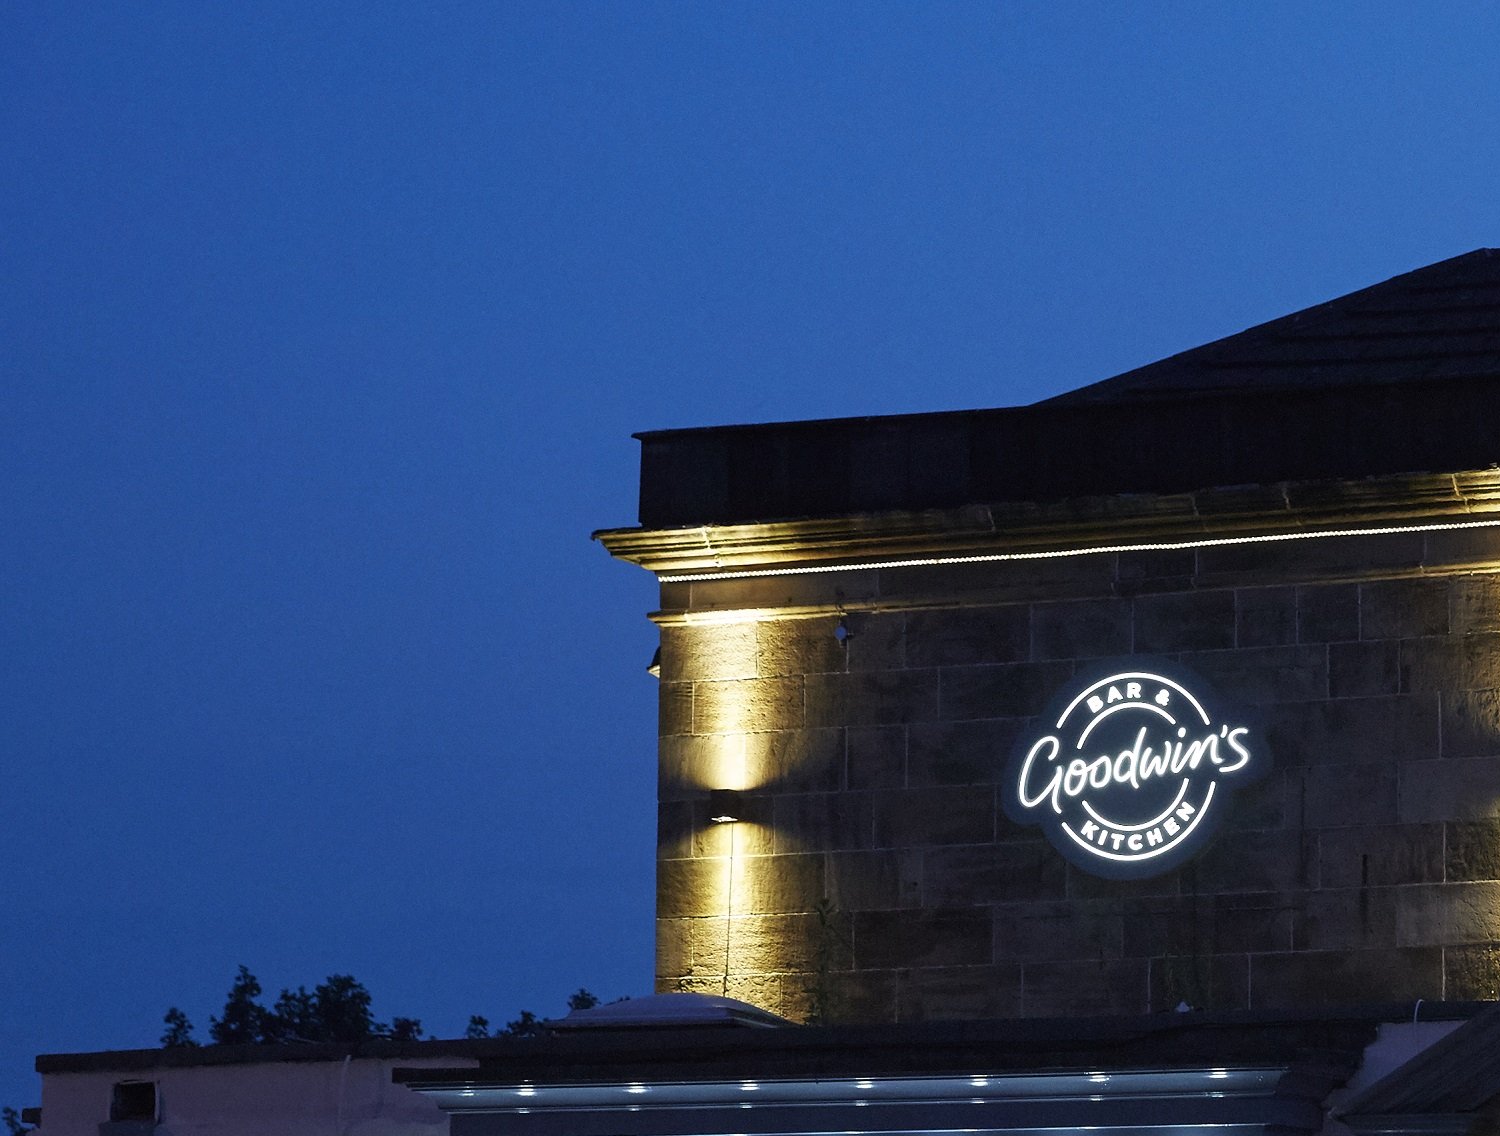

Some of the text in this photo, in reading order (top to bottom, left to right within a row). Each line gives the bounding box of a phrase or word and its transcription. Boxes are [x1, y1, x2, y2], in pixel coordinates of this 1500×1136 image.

[1086, 682, 1170, 713] BAR &
[1018, 725, 1250, 815] Goodwin's
[1080, 801, 1196, 852] KITCHEN
